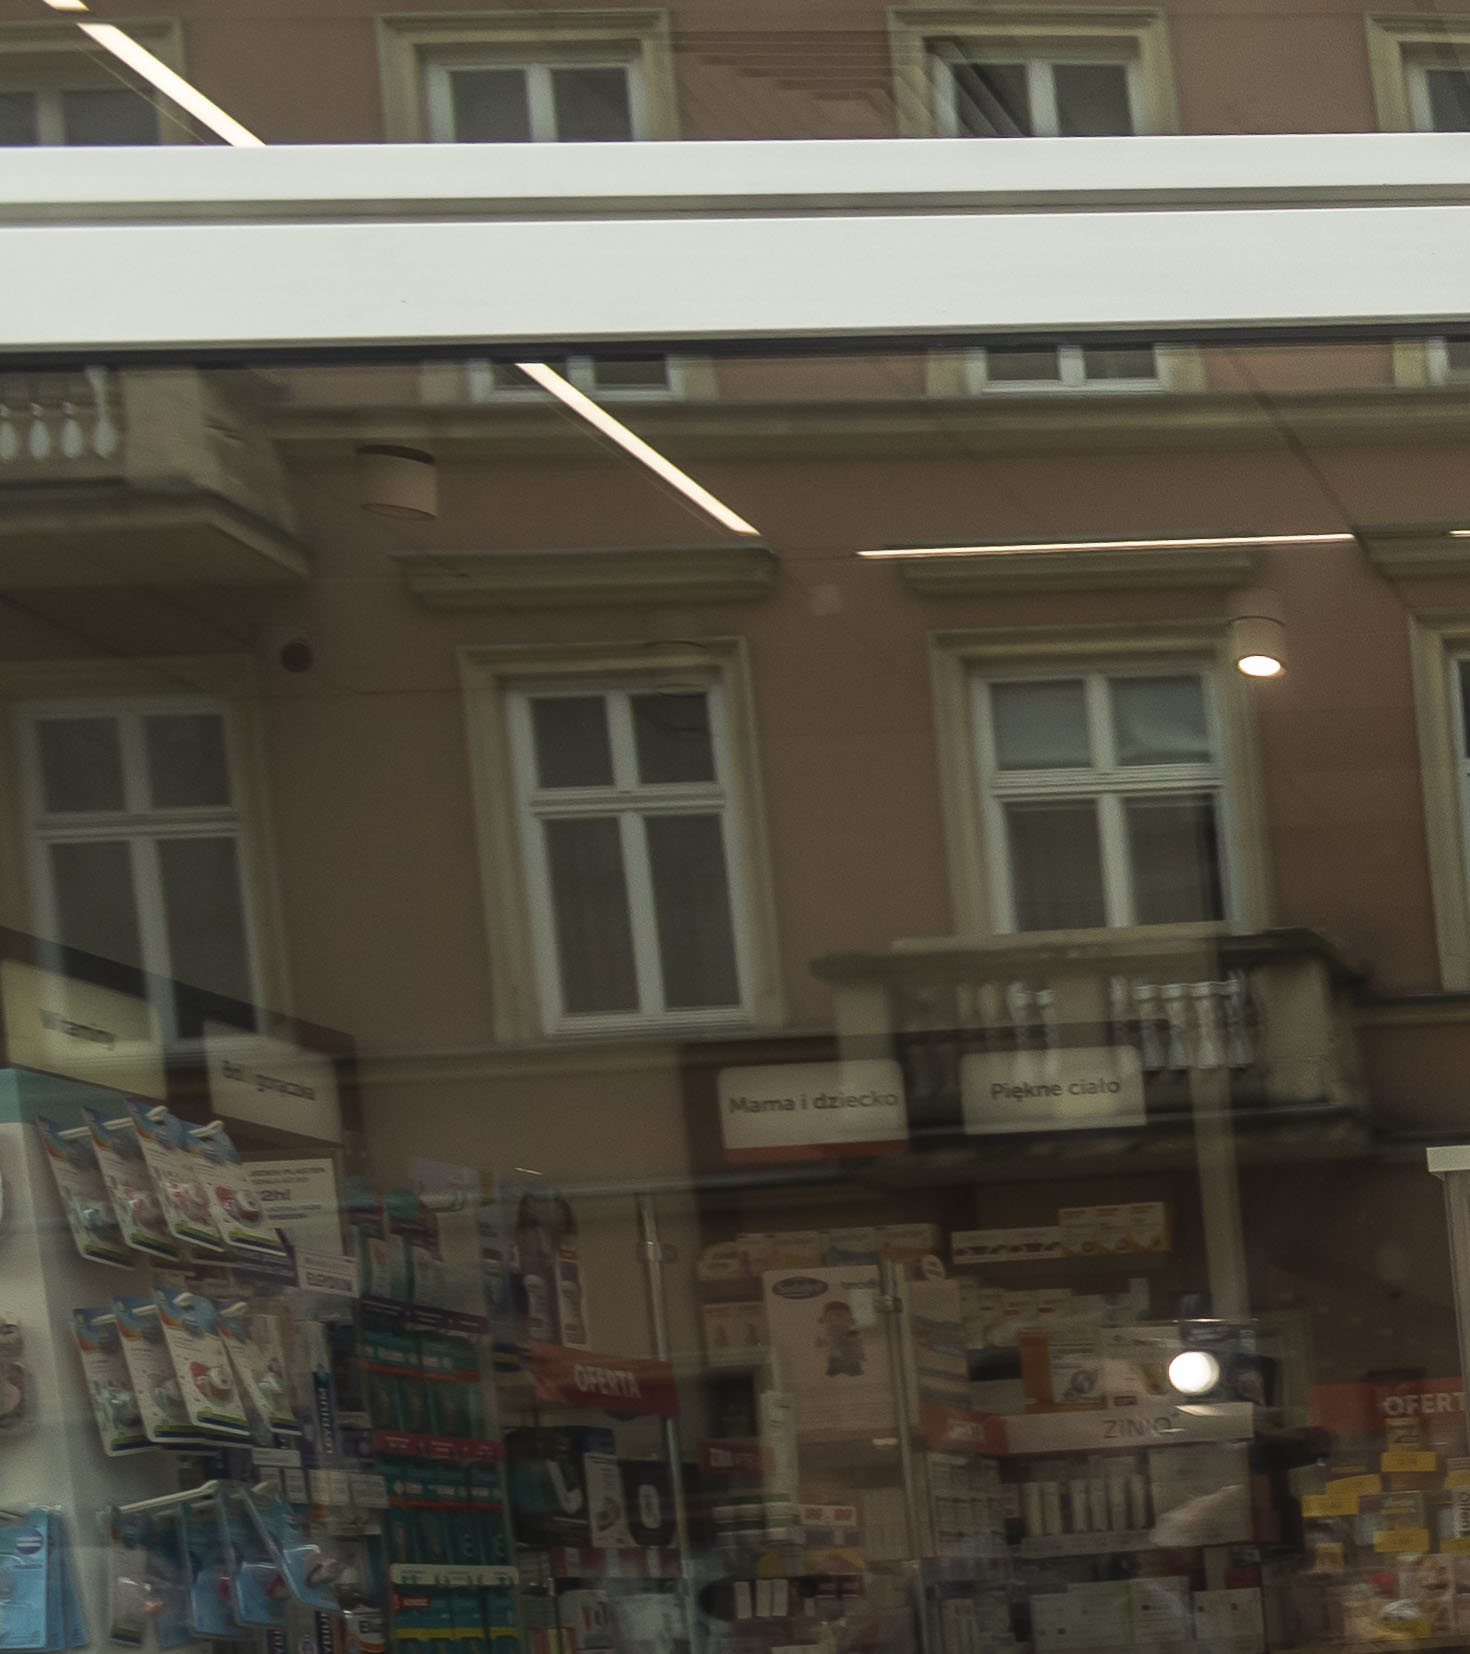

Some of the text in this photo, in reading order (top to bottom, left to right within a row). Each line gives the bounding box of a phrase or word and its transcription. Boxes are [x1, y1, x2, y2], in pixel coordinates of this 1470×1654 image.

[728, 1090, 899, 1115] Mama i dziecko
[990, 1077, 1121, 1103] Piękne ciało
[574, 1363, 642, 1401] OFERTA
